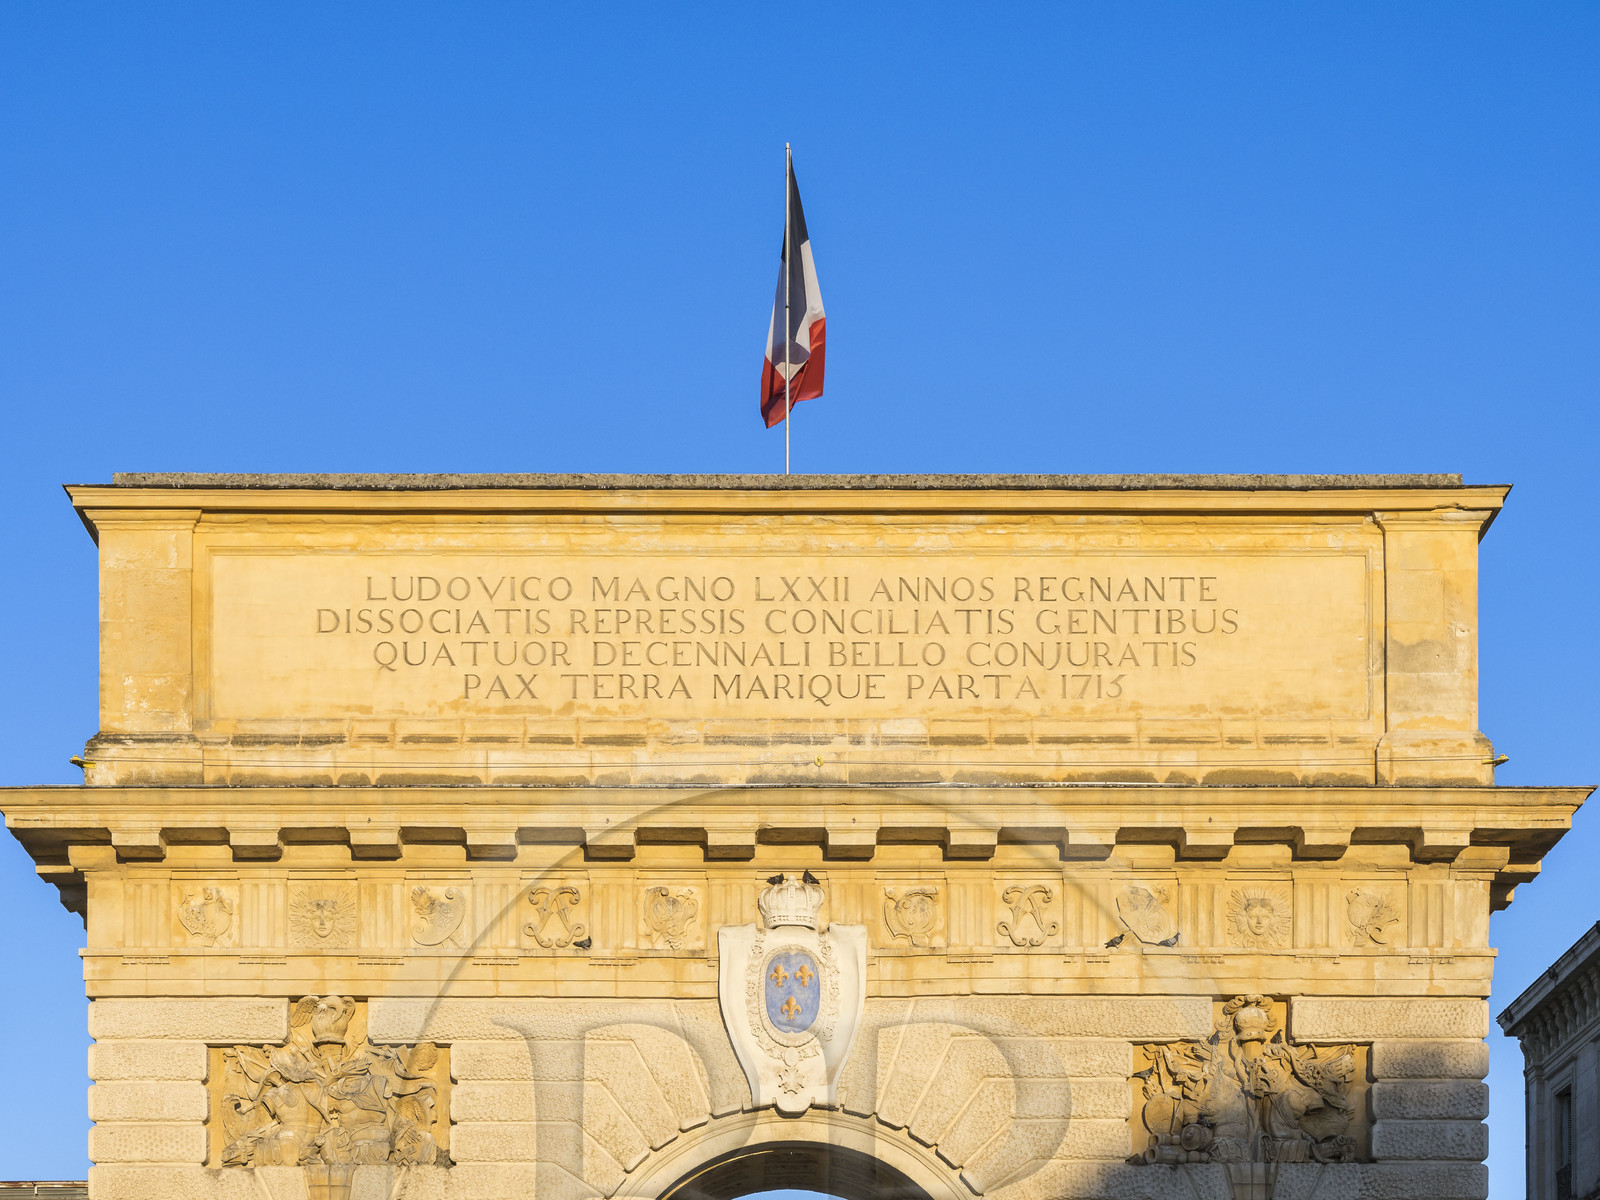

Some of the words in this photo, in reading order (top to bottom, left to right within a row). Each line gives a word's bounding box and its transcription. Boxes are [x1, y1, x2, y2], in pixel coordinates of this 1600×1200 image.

[366, 576, 573, 602] LUDOVICO
[591, 576, 735, 602] MAGNO
[754, 576, 850, 602] LXXII
[869, 576, 995, 602] ANNOS
[1013, 576, 1218, 602] REGNANTE
[315, 608, 551, 635] DISSOCIATIS
[568, 608, 745, 635] REPRESSIS
[764, 608, 1015, 635] CONCILIATIS
[1035, 608, 1239, 635] GENTIBUS
[373, 641, 572, 672] QUATUOR
[591, 641, 811, 667] DECENNALI
[828, 641, 946, 667] BELLO
[965, 641, 1197, 671] CONJURATIS
[463, 673, 539, 700] PAX
[560, 673, 692, 700] TERRA
[712, 673, 886, 707] MARIQUE
[906, 673, 1044, 700] PARTA
[1060, 673, 1126, 700] 1715
